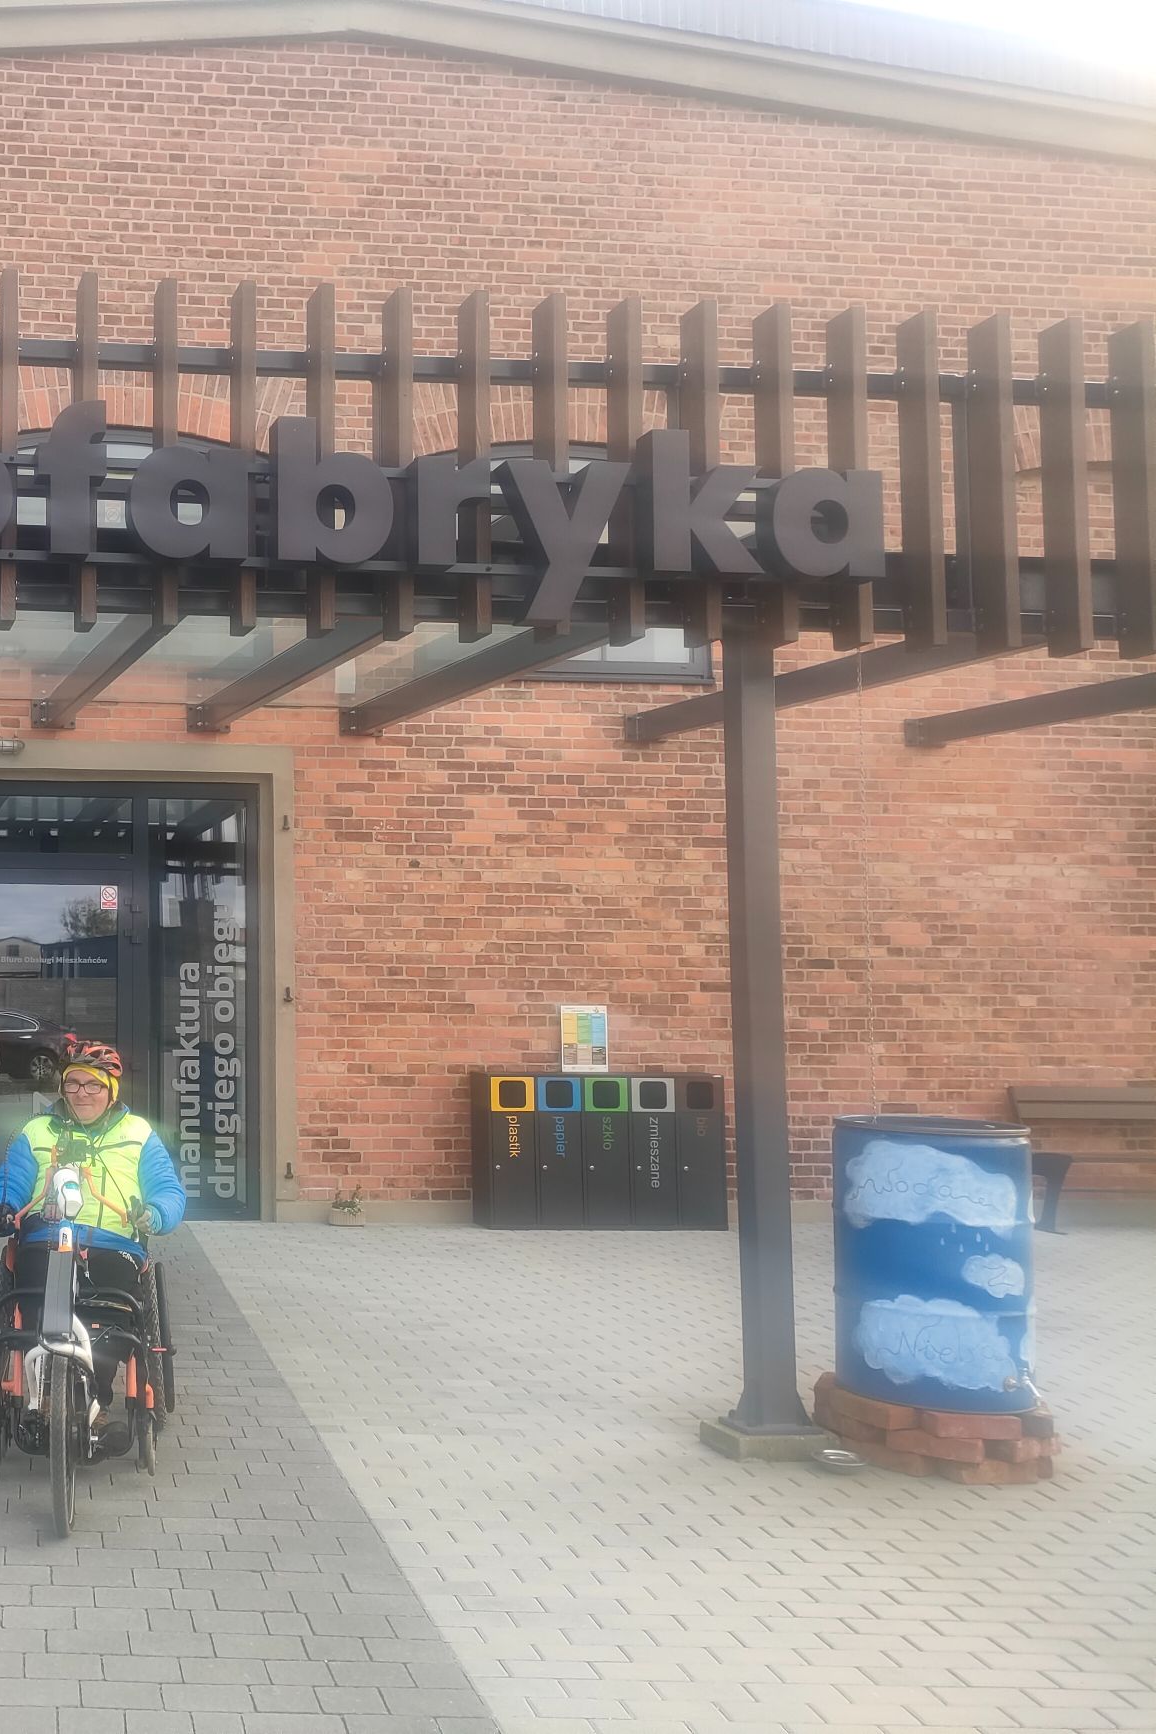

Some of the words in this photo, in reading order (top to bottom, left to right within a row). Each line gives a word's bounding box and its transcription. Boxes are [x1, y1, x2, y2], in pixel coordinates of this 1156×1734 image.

[56, 956, 108, 964] Mieszkańców
[207, 904, 241, 1023] obiegu
[172, 962, 201, 1198] manufaktura
[207, 1032, 241, 1198] drugiego
[505, 1115, 521, 1158] plastik
[552, 1116, 566, 1158] papier
[697, 1117, 709, 1137] bio
[649, 1117, 662, 1189] zmieszane
